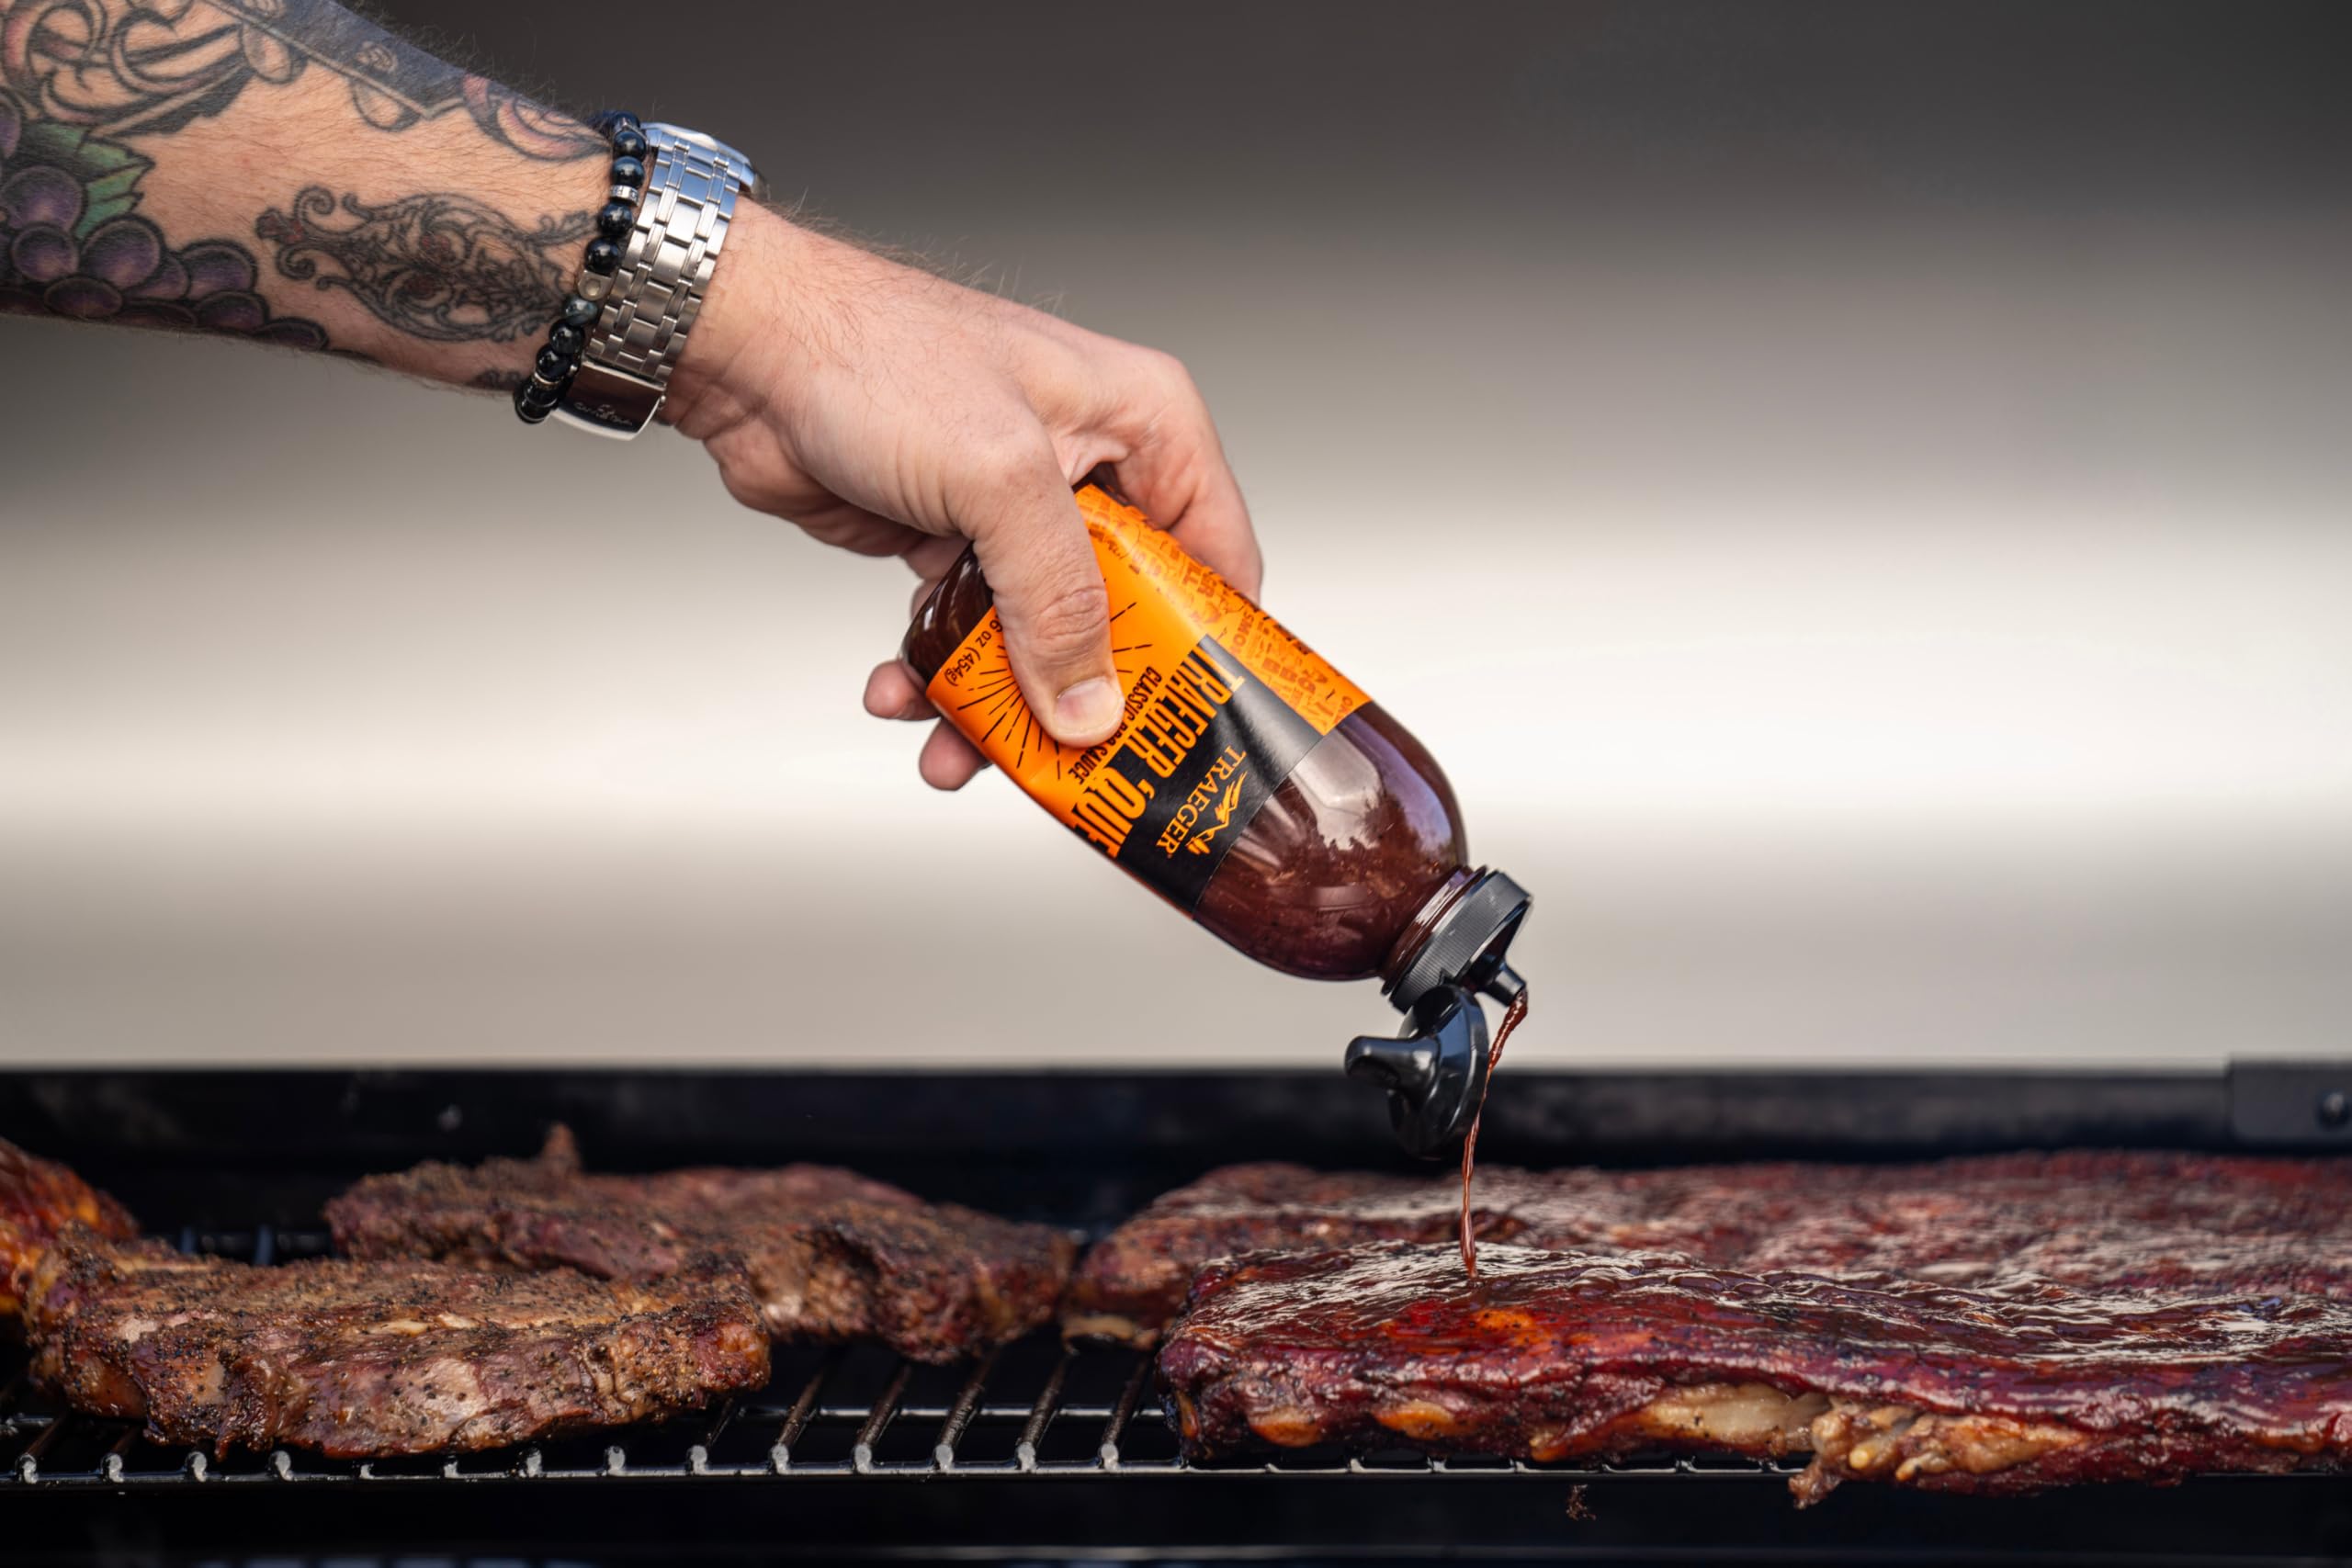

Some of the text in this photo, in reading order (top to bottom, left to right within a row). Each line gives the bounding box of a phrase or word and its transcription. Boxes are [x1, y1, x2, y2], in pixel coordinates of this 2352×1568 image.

[944, 647, 981, 687] (454g)
[976, 631, 991, 647] oz
[1069, 667, 1161, 784] CLASSIC SAUCE
[1121, 642, 1247, 777] TRAEGER
[1157, 745, 1246, 853] TRAEGER
